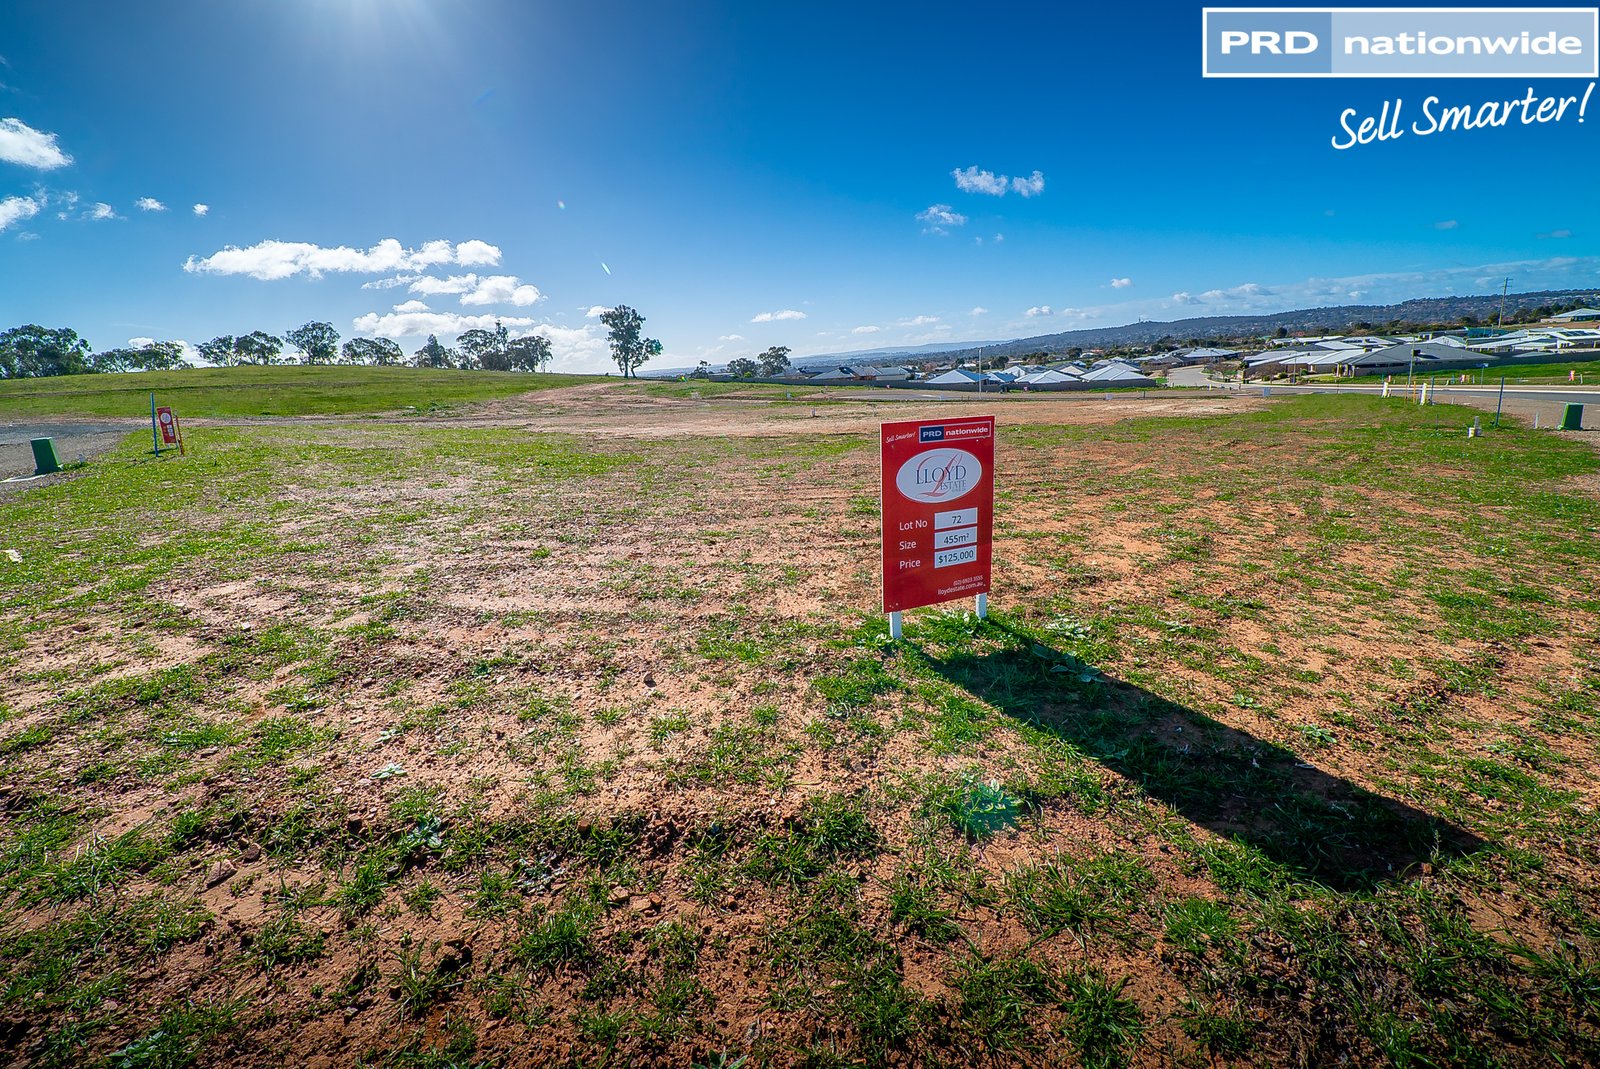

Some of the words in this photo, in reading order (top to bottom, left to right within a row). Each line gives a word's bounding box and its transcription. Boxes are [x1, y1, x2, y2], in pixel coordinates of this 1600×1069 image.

[922, 430, 942, 438] PRD
[945, 427, 989, 437] nationwide
[885, 435, 894, 443] Sell
[915, 465, 967, 485] LLOYD
[940, 479, 967, 491] ESTATE
[899, 521, 913, 531] Lot
[915, 519, 928, 529] No
[951, 515, 962, 524] 72
[899, 541, 917, 551] Size
[938, 549, 974, 564] $125,000
[899, 559, 921, 570] Price
[937, 581, 984, 596] lloydestate.com.au
